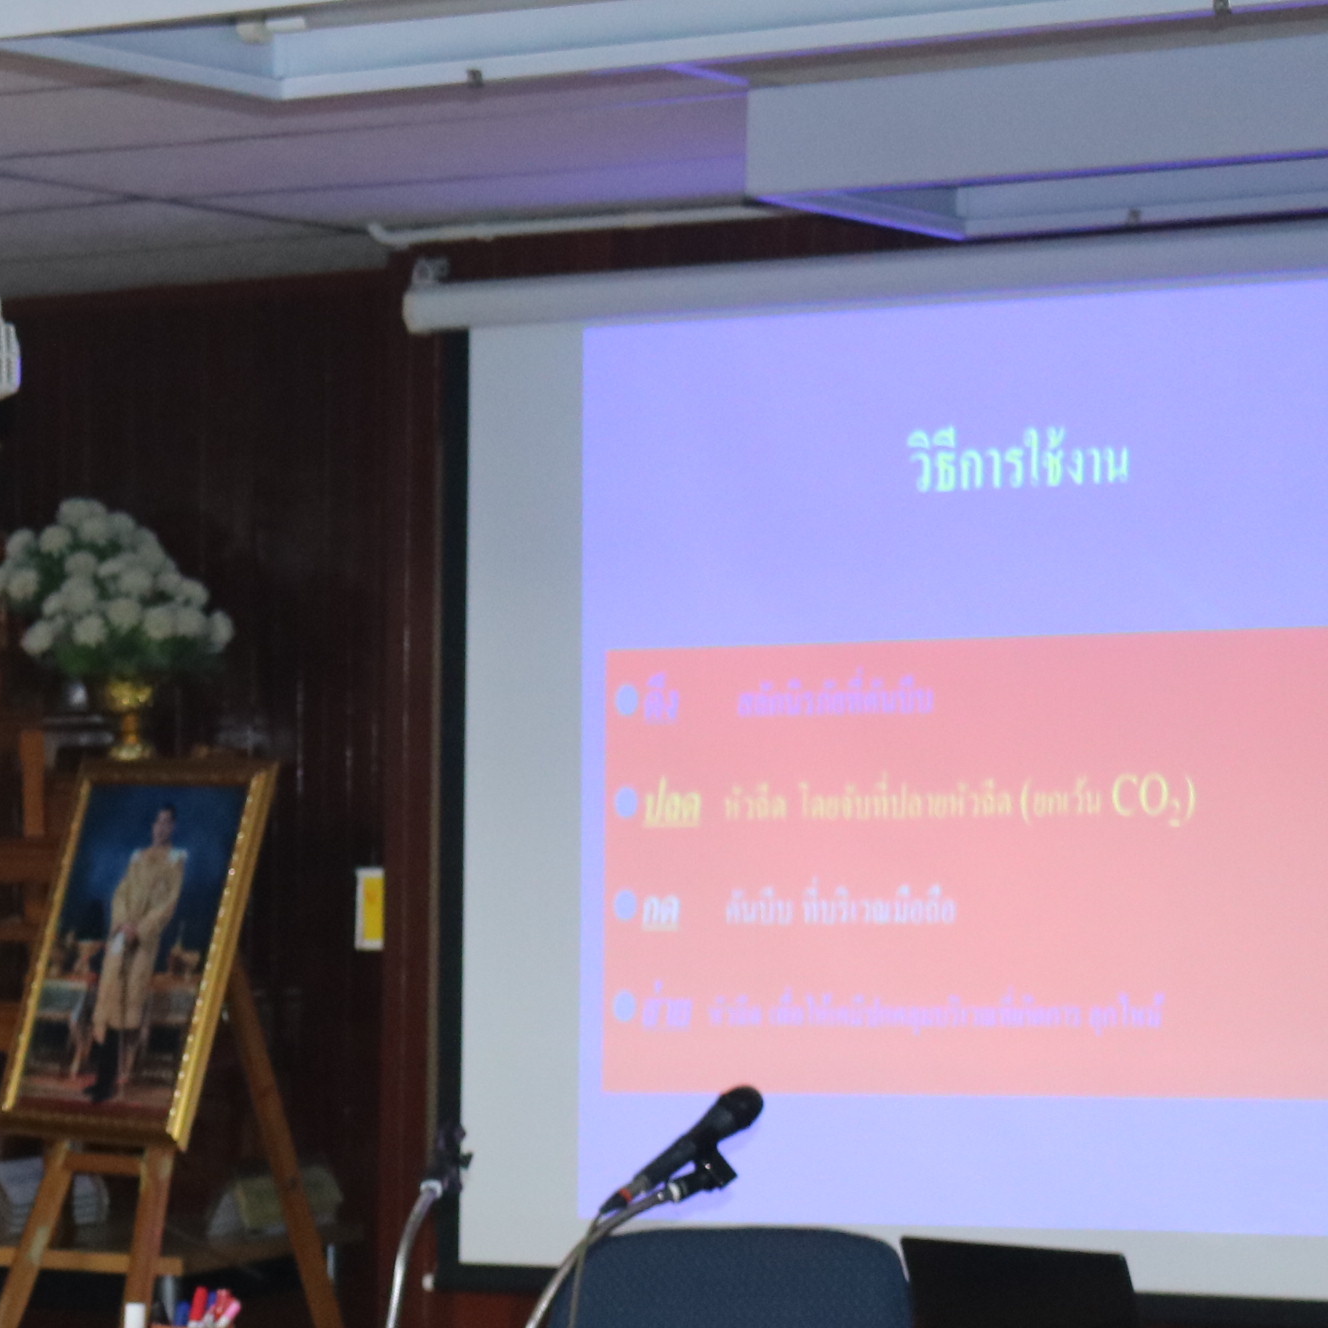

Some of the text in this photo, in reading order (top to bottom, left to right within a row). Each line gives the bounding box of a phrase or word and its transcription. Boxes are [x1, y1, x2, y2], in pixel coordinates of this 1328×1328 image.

[906, 425, 1130, 493] วิธีการใช้งาน
